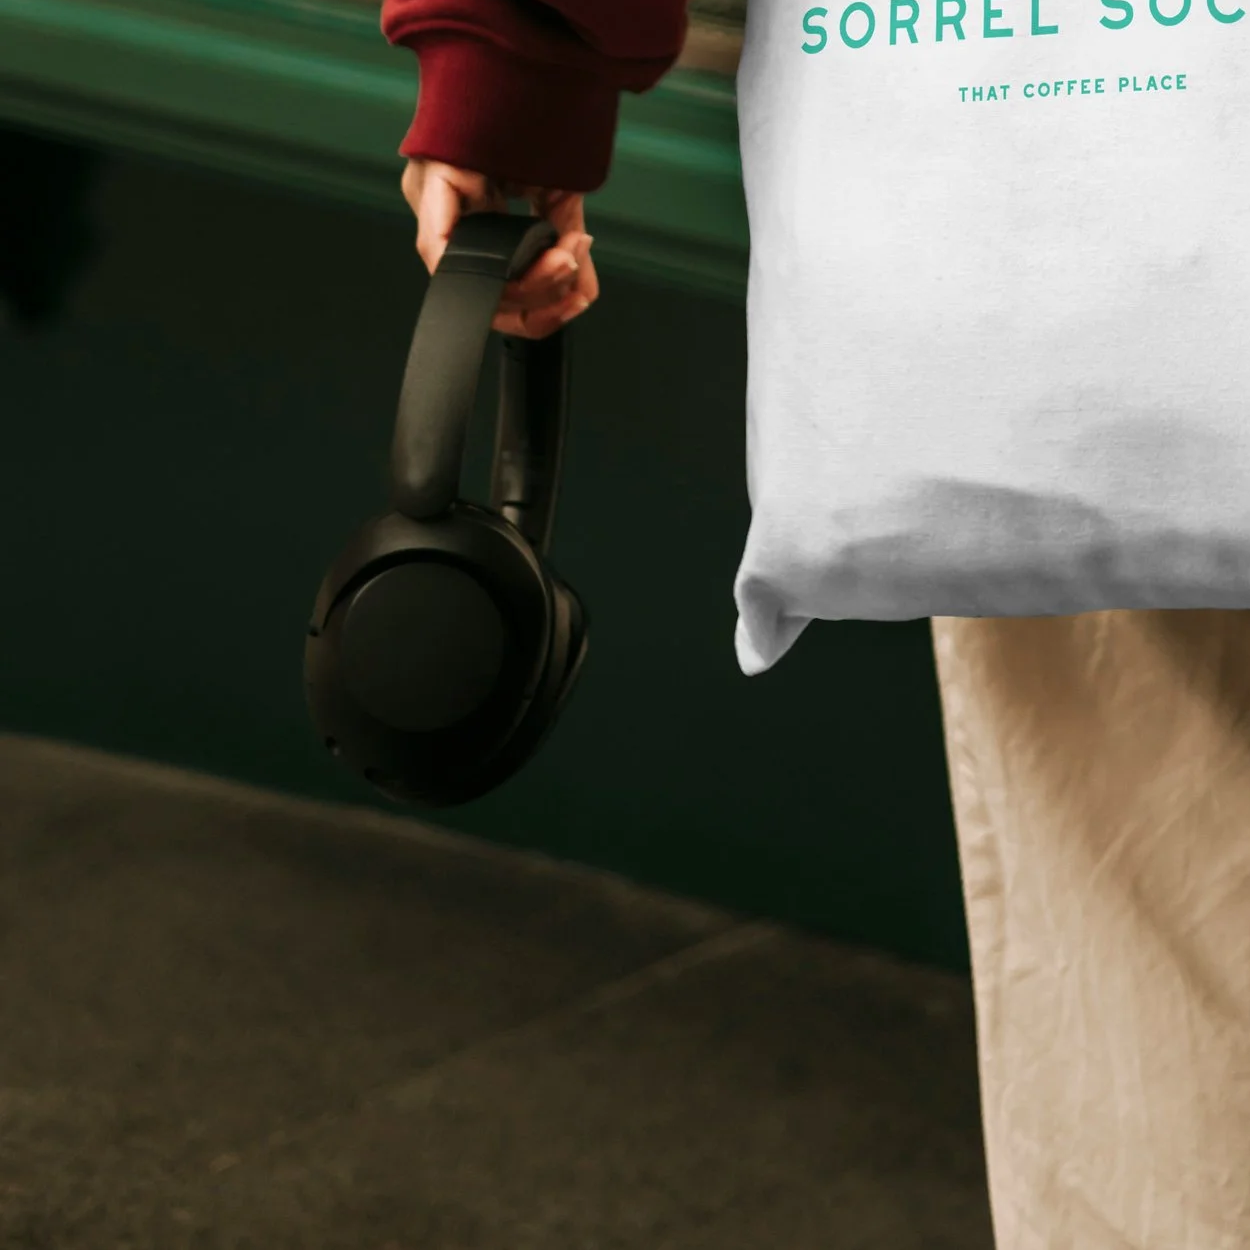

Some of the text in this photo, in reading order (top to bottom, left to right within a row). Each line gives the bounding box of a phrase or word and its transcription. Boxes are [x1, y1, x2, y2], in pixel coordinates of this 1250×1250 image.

[958, 74, 1187, 102] THAT COFFEE PLACE
